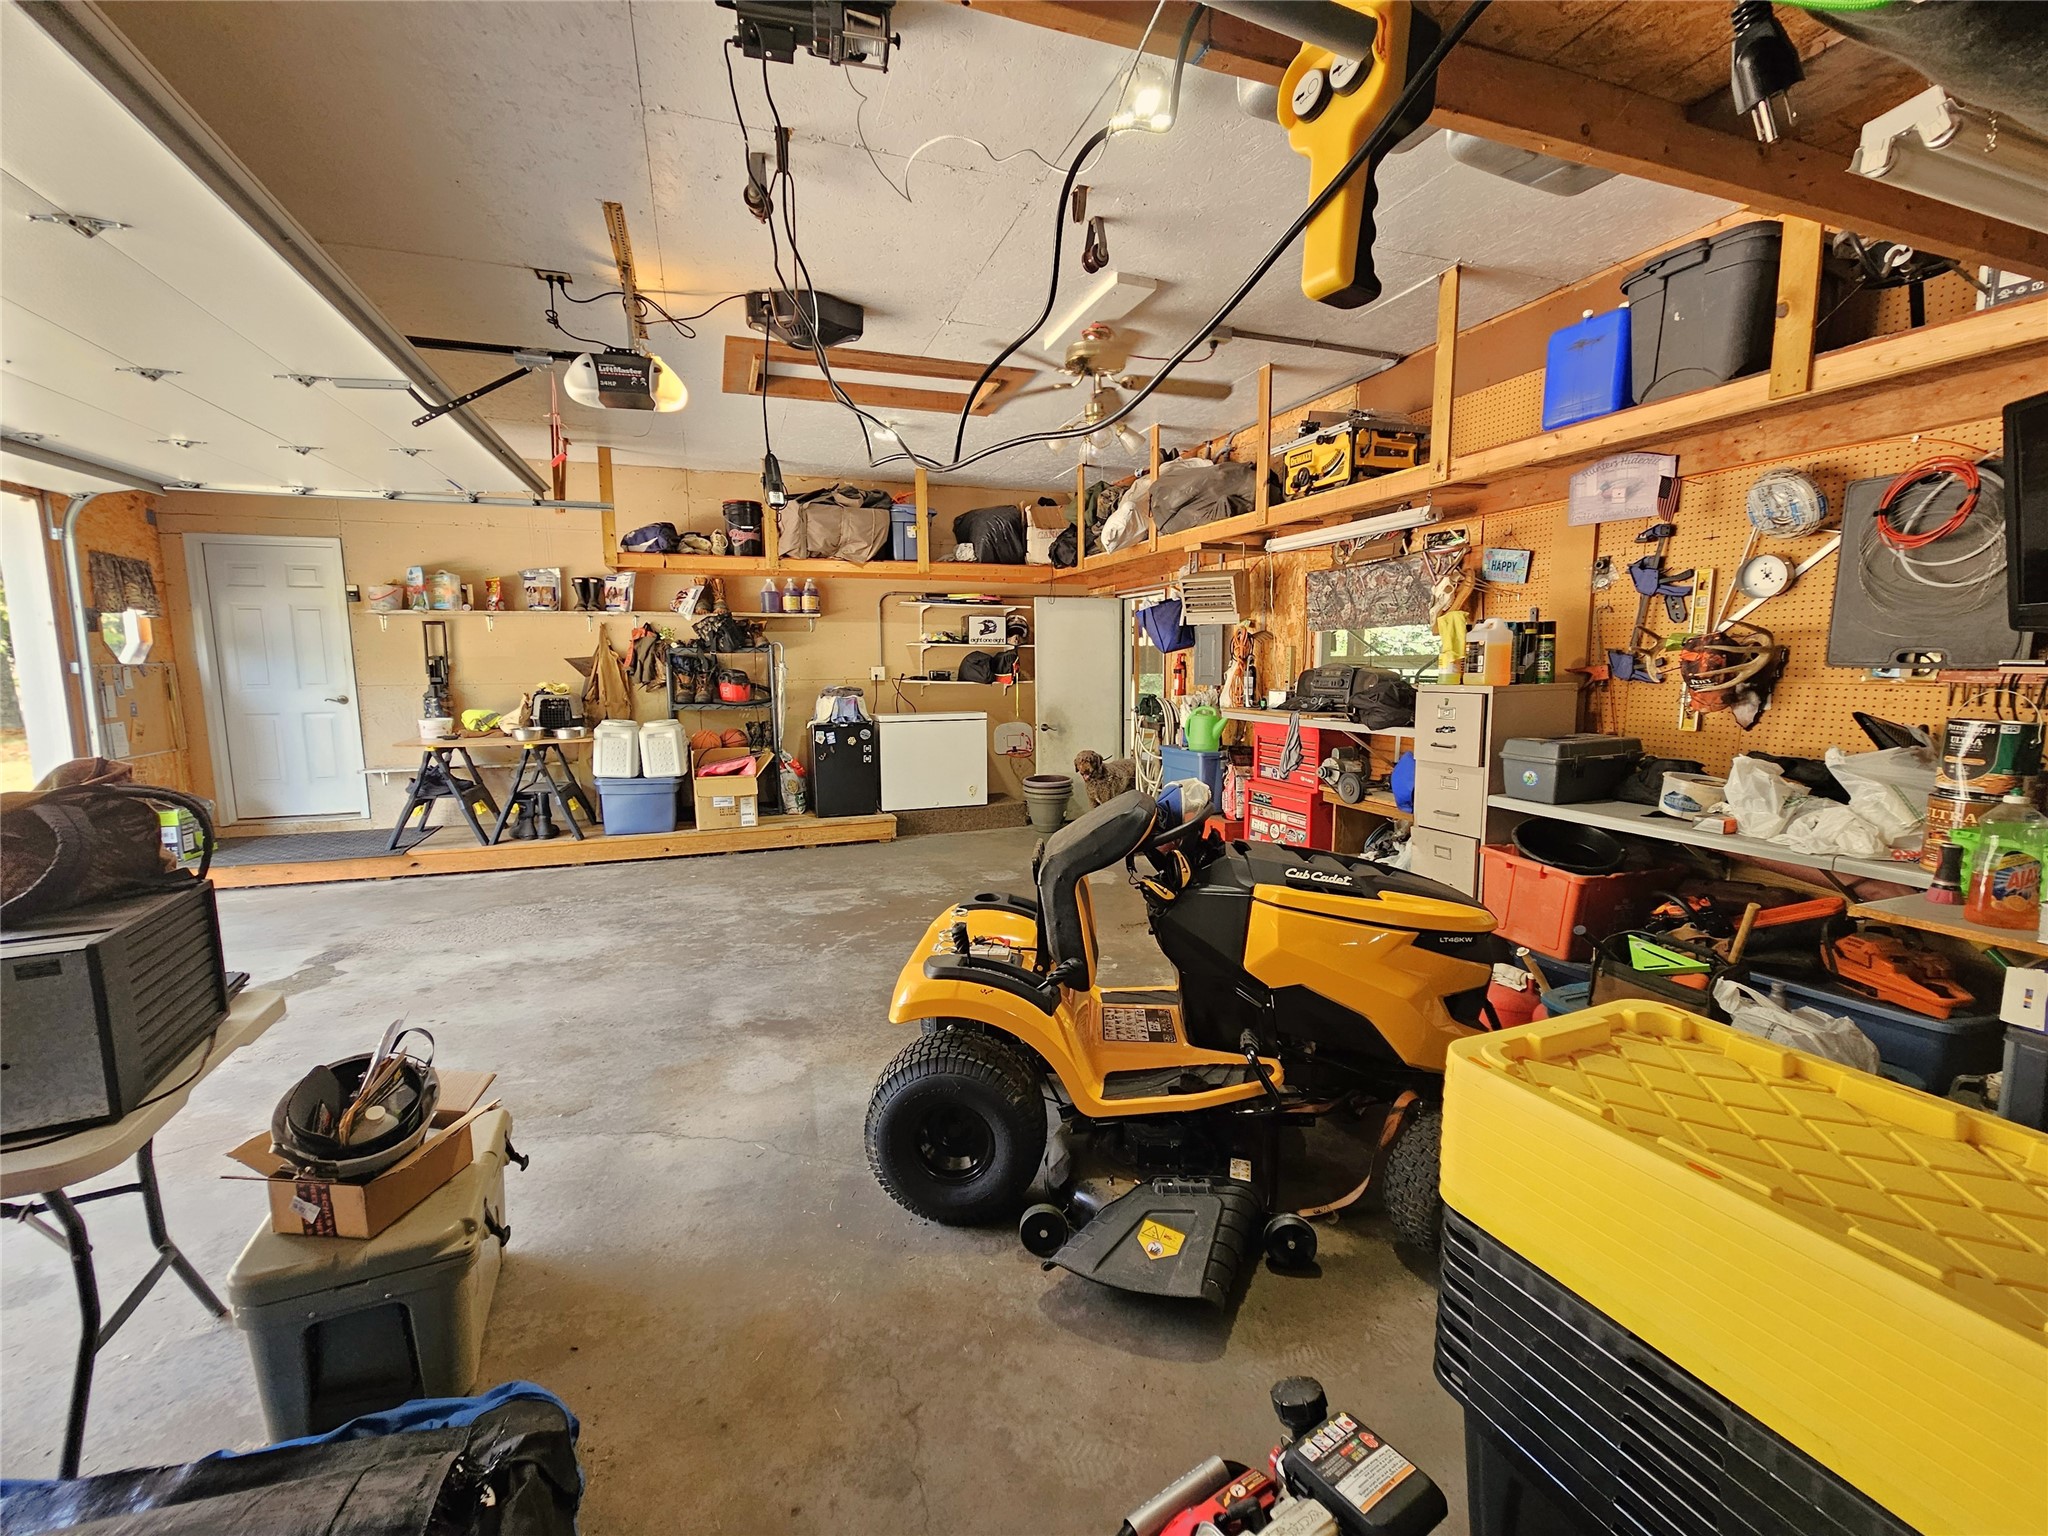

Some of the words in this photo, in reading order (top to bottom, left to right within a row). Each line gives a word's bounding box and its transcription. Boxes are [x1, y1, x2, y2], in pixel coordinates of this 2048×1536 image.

[598, 365, 642, 375] LiftMaster
[1620, 455, 1662, 466] Hideout
[1491, 560, 1518, 572] HAPPY
[1285, 868, 1310, 879] Cub
[1310, 871, 1353, 886] Cadet
